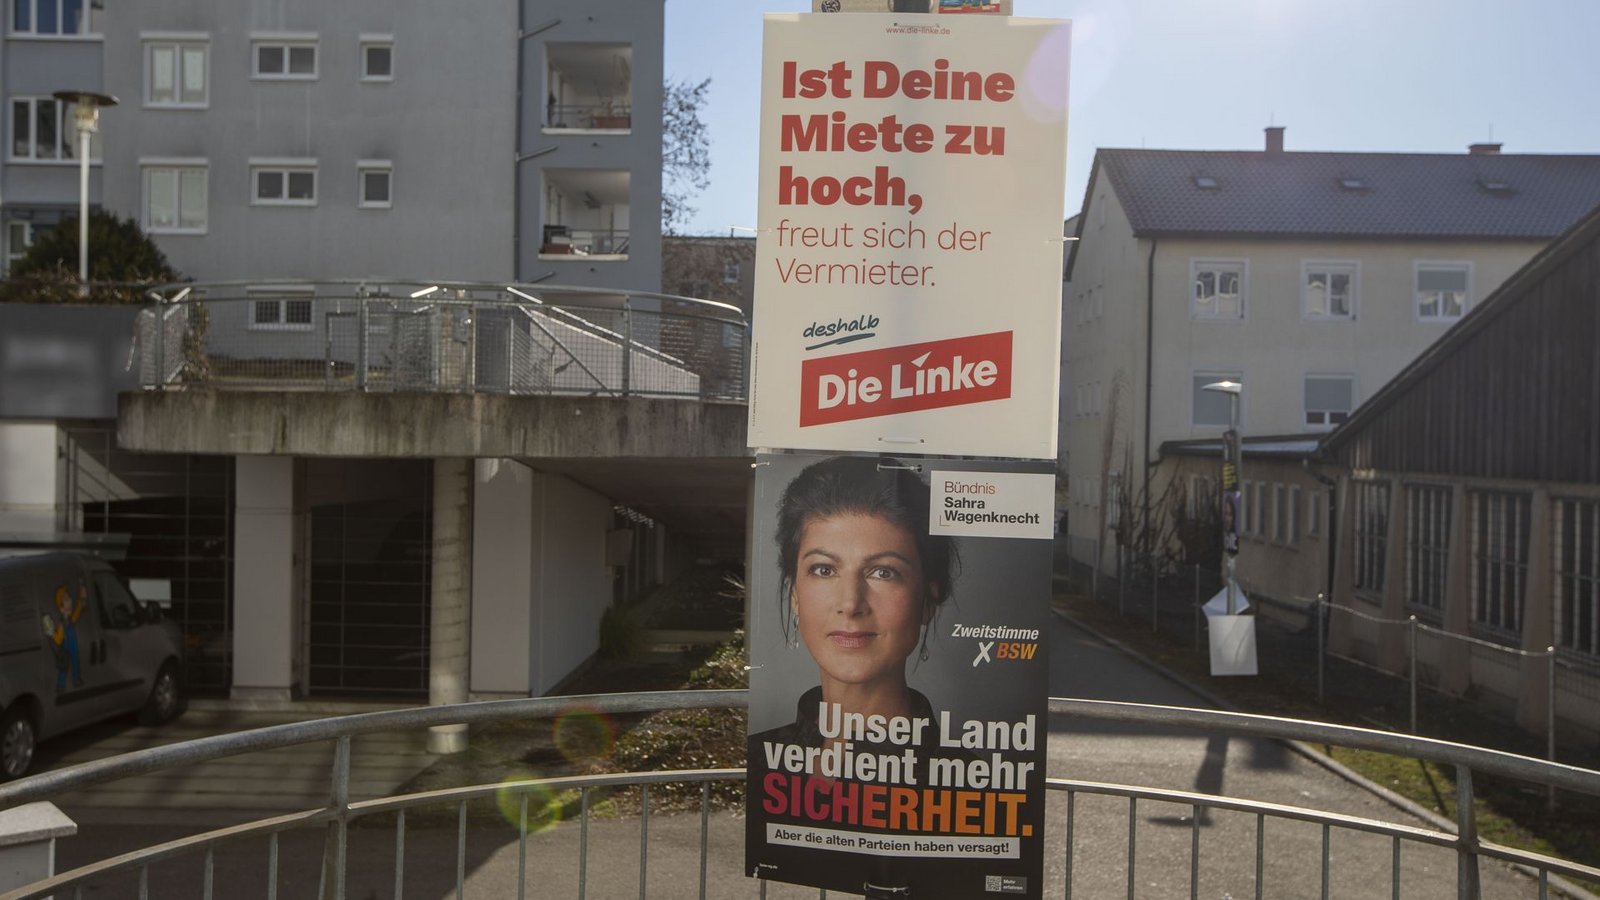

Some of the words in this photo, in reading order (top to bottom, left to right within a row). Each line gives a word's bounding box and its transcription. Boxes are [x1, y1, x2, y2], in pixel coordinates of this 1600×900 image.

[886, 26, 951, 36] www.die-linke.de
[781, 60, 852, 99] Ist
[863, 58, 1015, 103] Deine
[780, 110, 934, 153] Miete
[944, 124, 1006, 156] zu
[778, 165, 923, 215] hoch,
[777, 219, 853, 248] freut
[862, 221, 926, 249] sich
[937, 222, 991, 251] der
[776, 258, 936, 287] Vermieter.
[802, 314, 880, 338] deshalb
[817, 368, 882, 410] Die
[890, 350, 998, 400] Linke
[944, 481, 996, 495] Bündnis
[944, 496, 985, 509] Sahra
[944, 510, 1040, 525] Wagenknecht
[951, 623, 1040, 640] Zweitstimme
[996, 642, 1038, 660] BSW
[818, 701, 930, 746] Unser
[939, 710, 1037, 751] Land
[763, 741, 918, 785] verdient
[928, 752, 1035, 790] mehr
[762, 771, 1033, 837] SICHERHEIT.
[774, 828, 802, 842] Aber
[804, 832, 823, 844] die
[825, 835, 855, 848] alten
[858, 837, 911, 851] Parteien
[914, 841, 955, 853] haben
[957, 842, 1010, 854] versagt!
